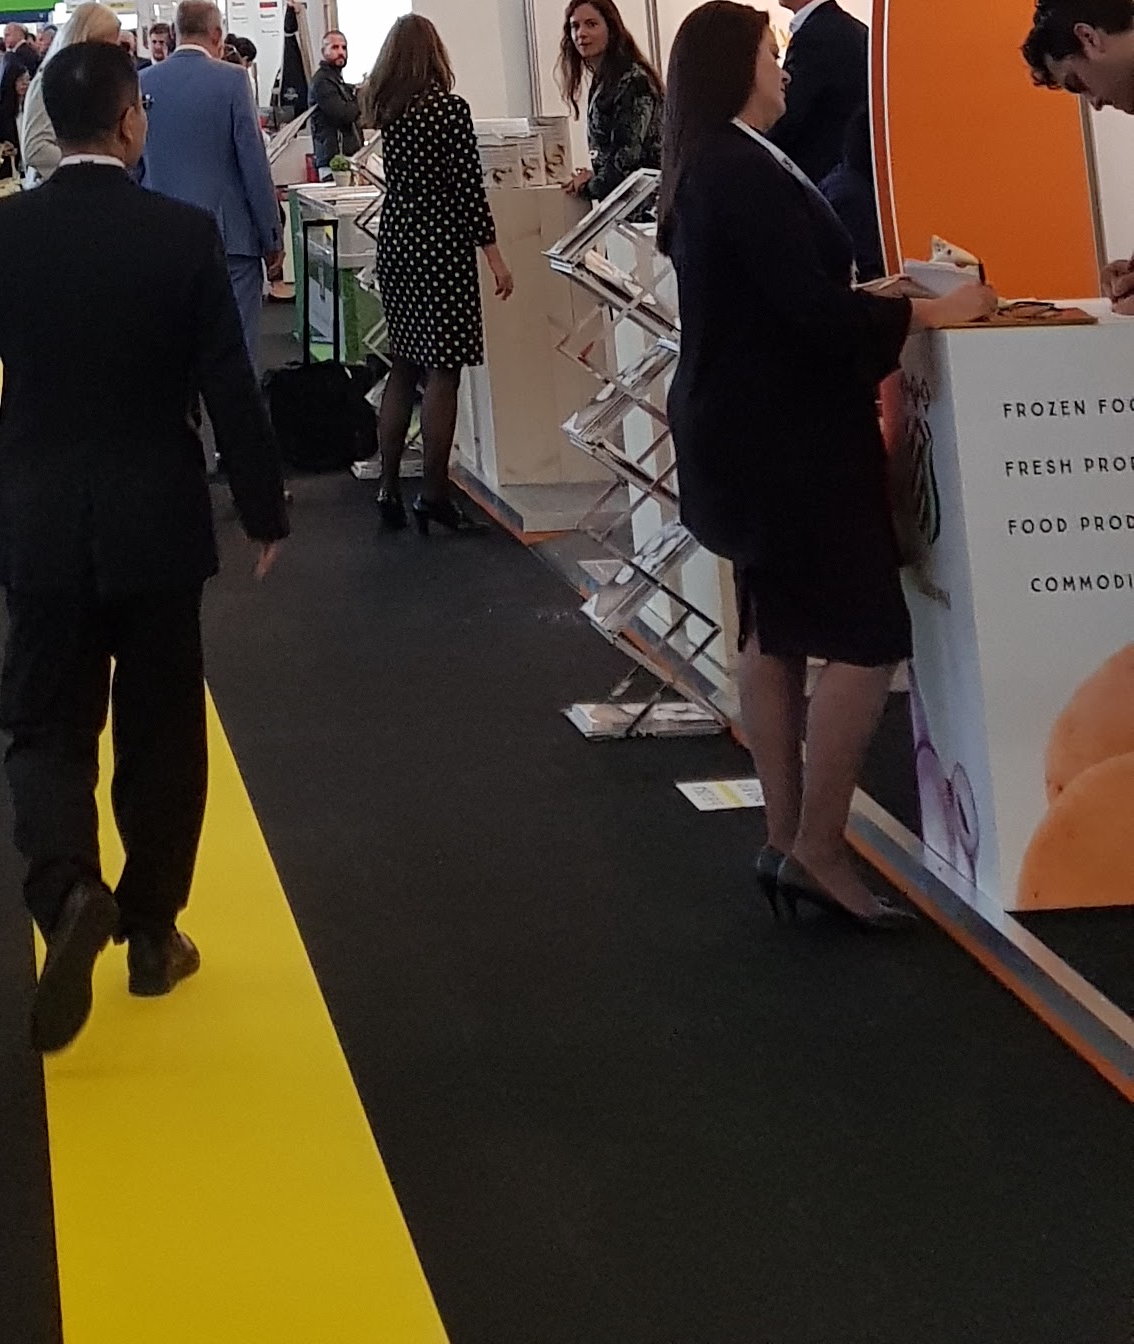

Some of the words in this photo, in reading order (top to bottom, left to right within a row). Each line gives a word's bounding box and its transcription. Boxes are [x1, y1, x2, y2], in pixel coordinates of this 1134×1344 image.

[1003, 400, 1085, 418] FROZEN
[1005, 459, 1071, 477] FRESH
[1008, 517, 1067, 535] FOOD
[1030, 573, 1134, 592] COMMODI
